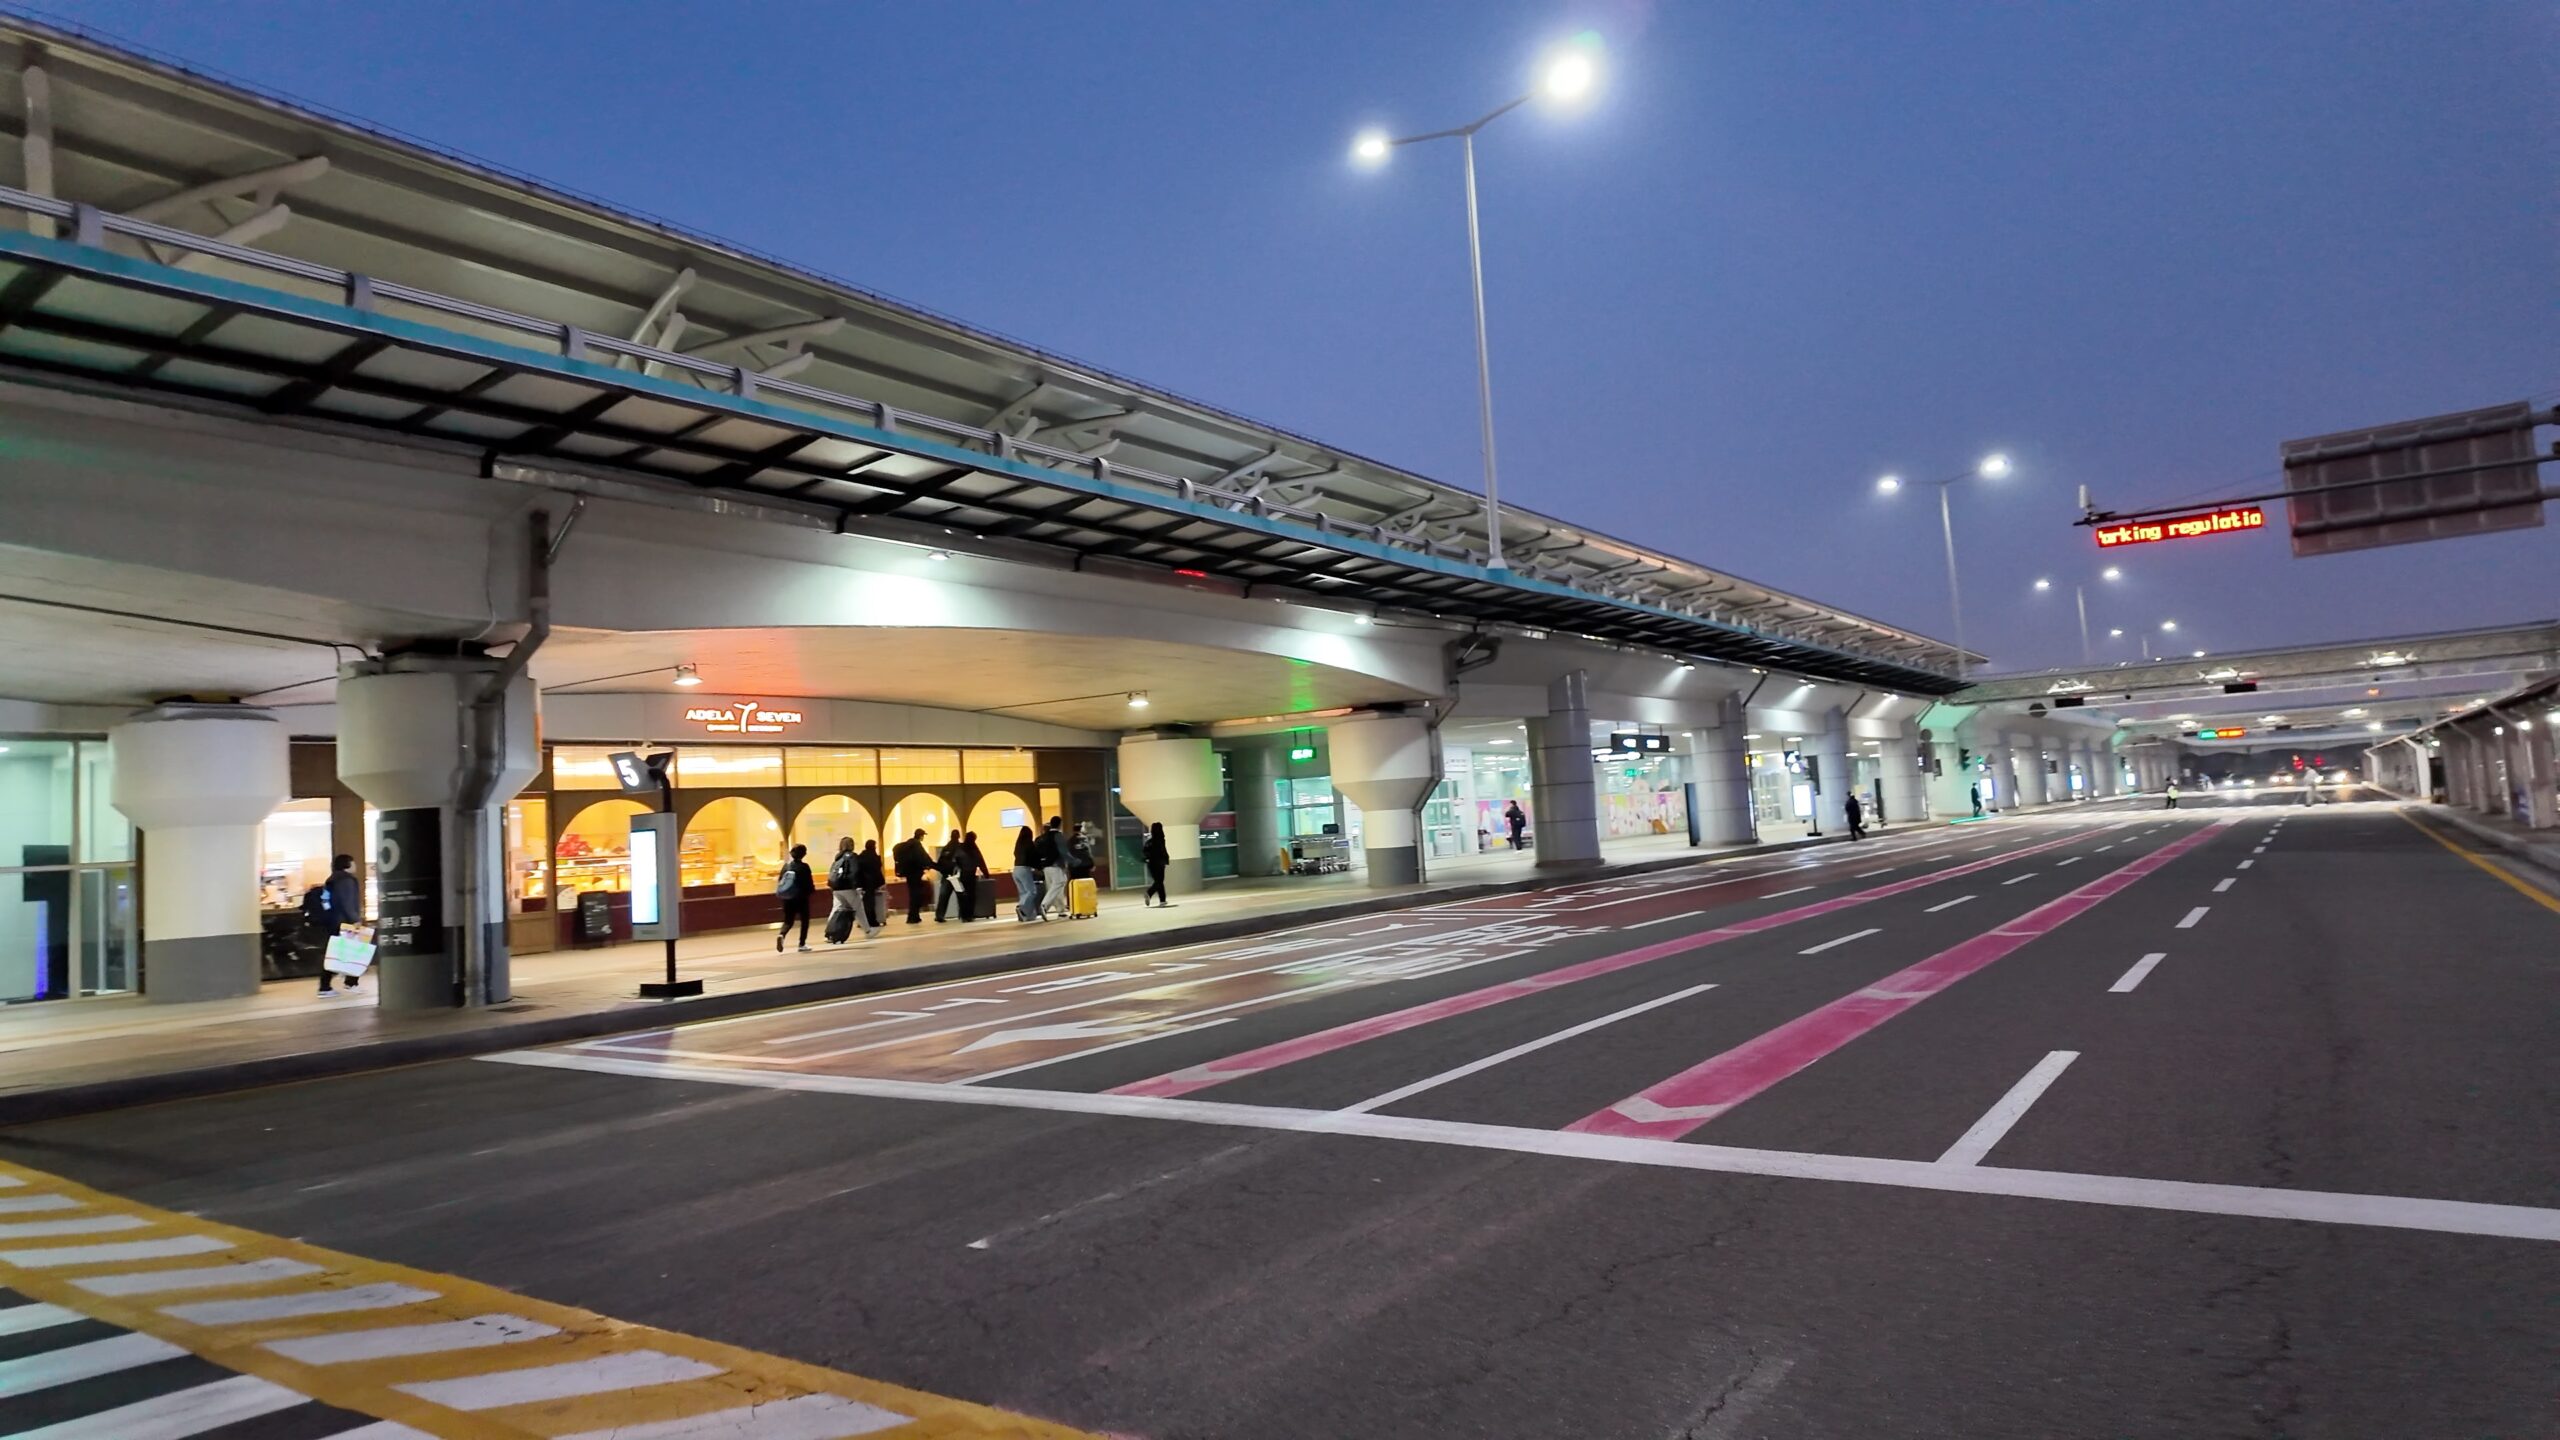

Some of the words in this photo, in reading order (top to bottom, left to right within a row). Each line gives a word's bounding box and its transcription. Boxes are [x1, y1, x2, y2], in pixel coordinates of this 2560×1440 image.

[685, 709, 735, 721] ADELA
[756, 711, 802, 723] SEVEN
[616, 759, 640, 787] 5
[377, 820, 400, 873] 5
